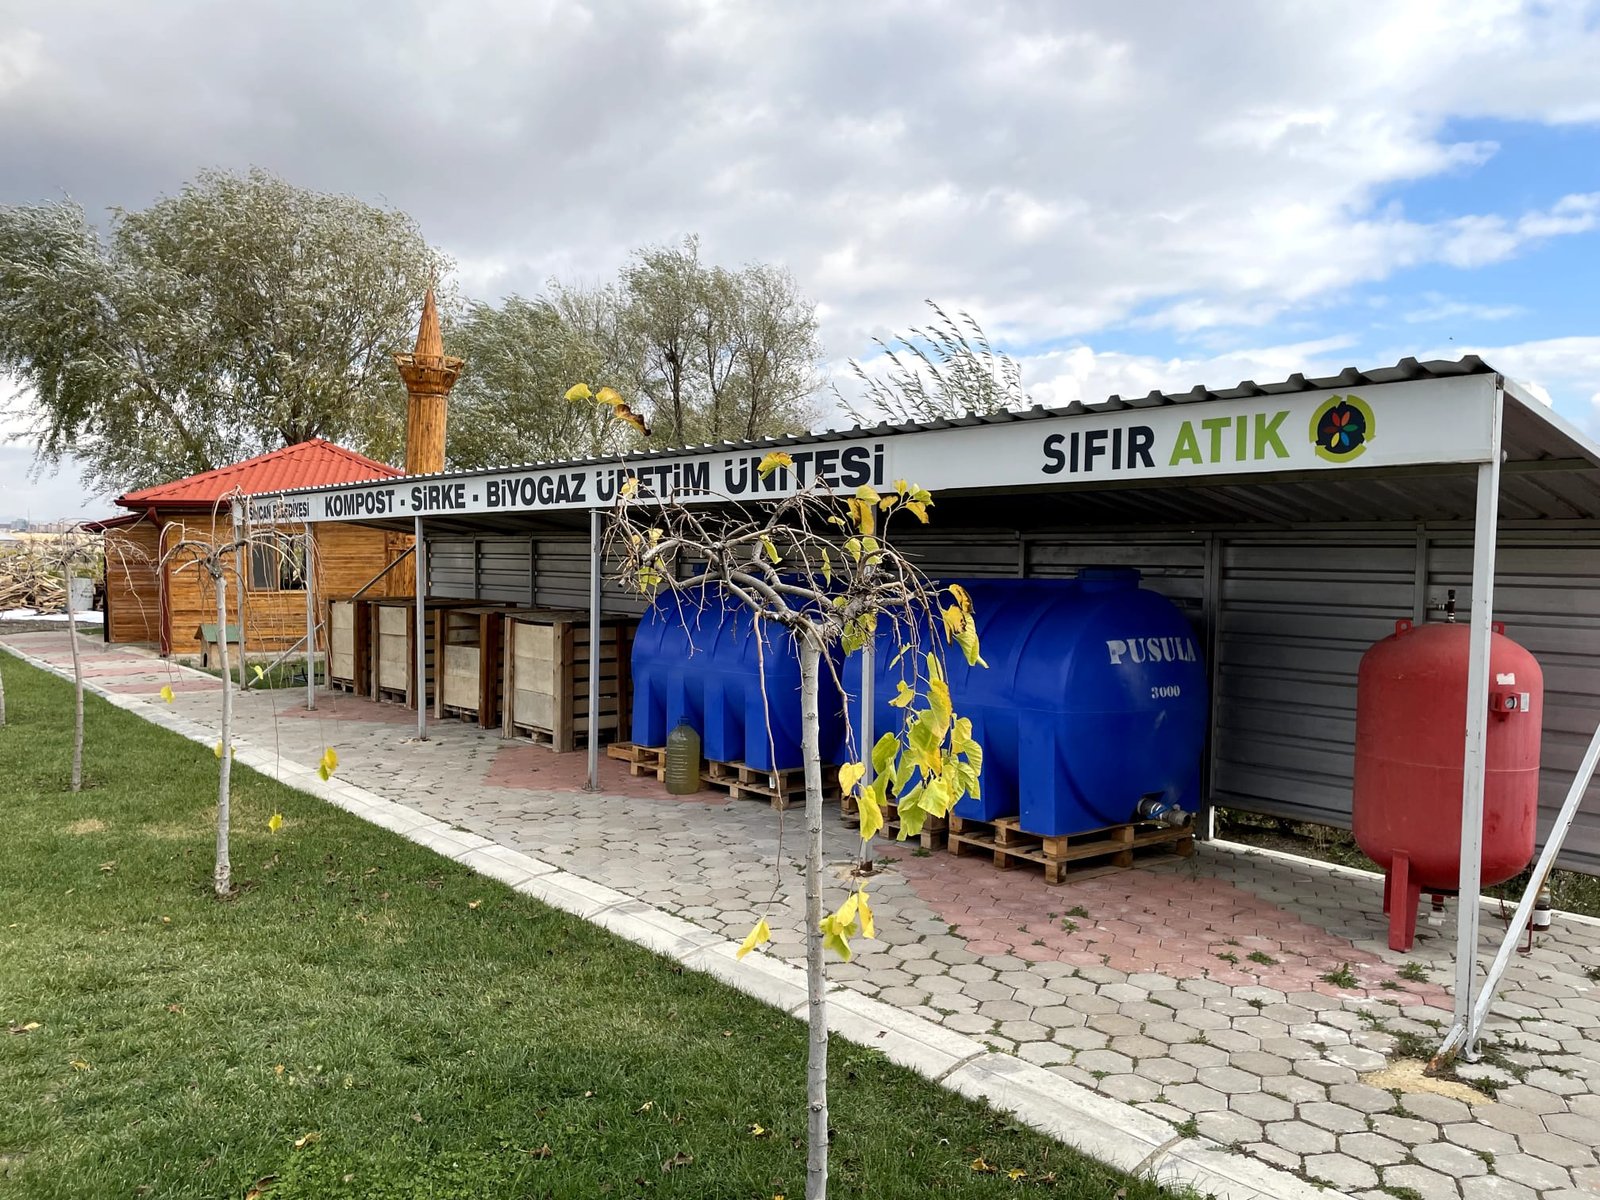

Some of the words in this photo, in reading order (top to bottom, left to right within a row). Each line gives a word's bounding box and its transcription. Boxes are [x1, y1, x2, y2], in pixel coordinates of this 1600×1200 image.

[1041, 425, 1156, 475] SIFIR
[1168, 410, 1291, 466] ATIK
[325, 489, 395, 517] KOMPOST
[411, 483, 466, 511] SİRKE
[486, 472, 586, 508] BİYOGAZ
[249, 503, 272, 520] SCAN
[1106, 637, 1197, 665] PUSULA
[1151, 685, 1181, 699] 3000
